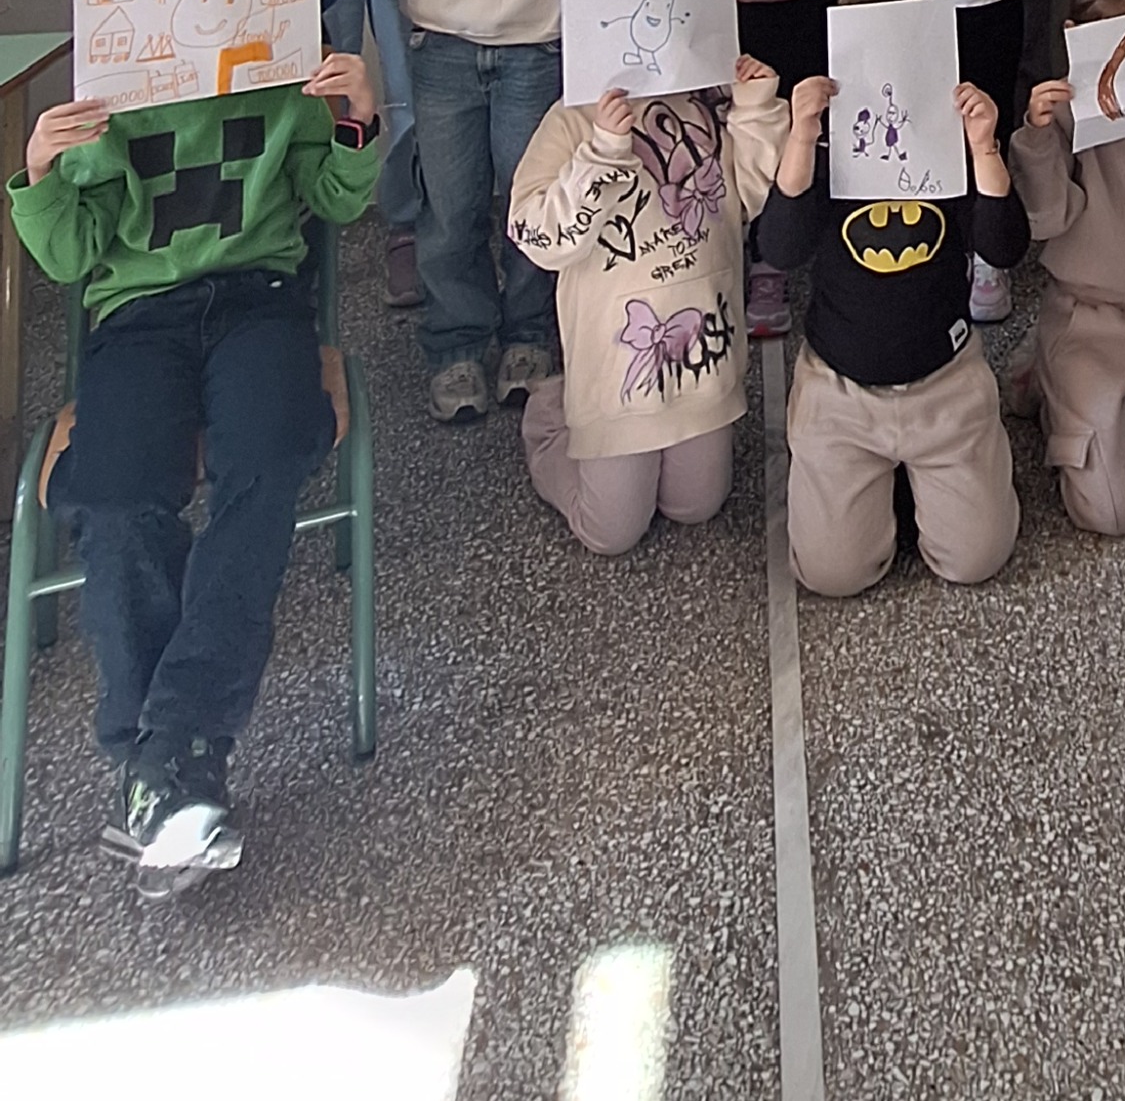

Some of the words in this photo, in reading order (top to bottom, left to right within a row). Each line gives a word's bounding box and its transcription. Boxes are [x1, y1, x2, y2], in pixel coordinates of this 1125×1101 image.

[638, 222, 684, 257] MAKE
[667, 227, 711, 258] TODAY
[650, 250, 699, 283] GREAT
